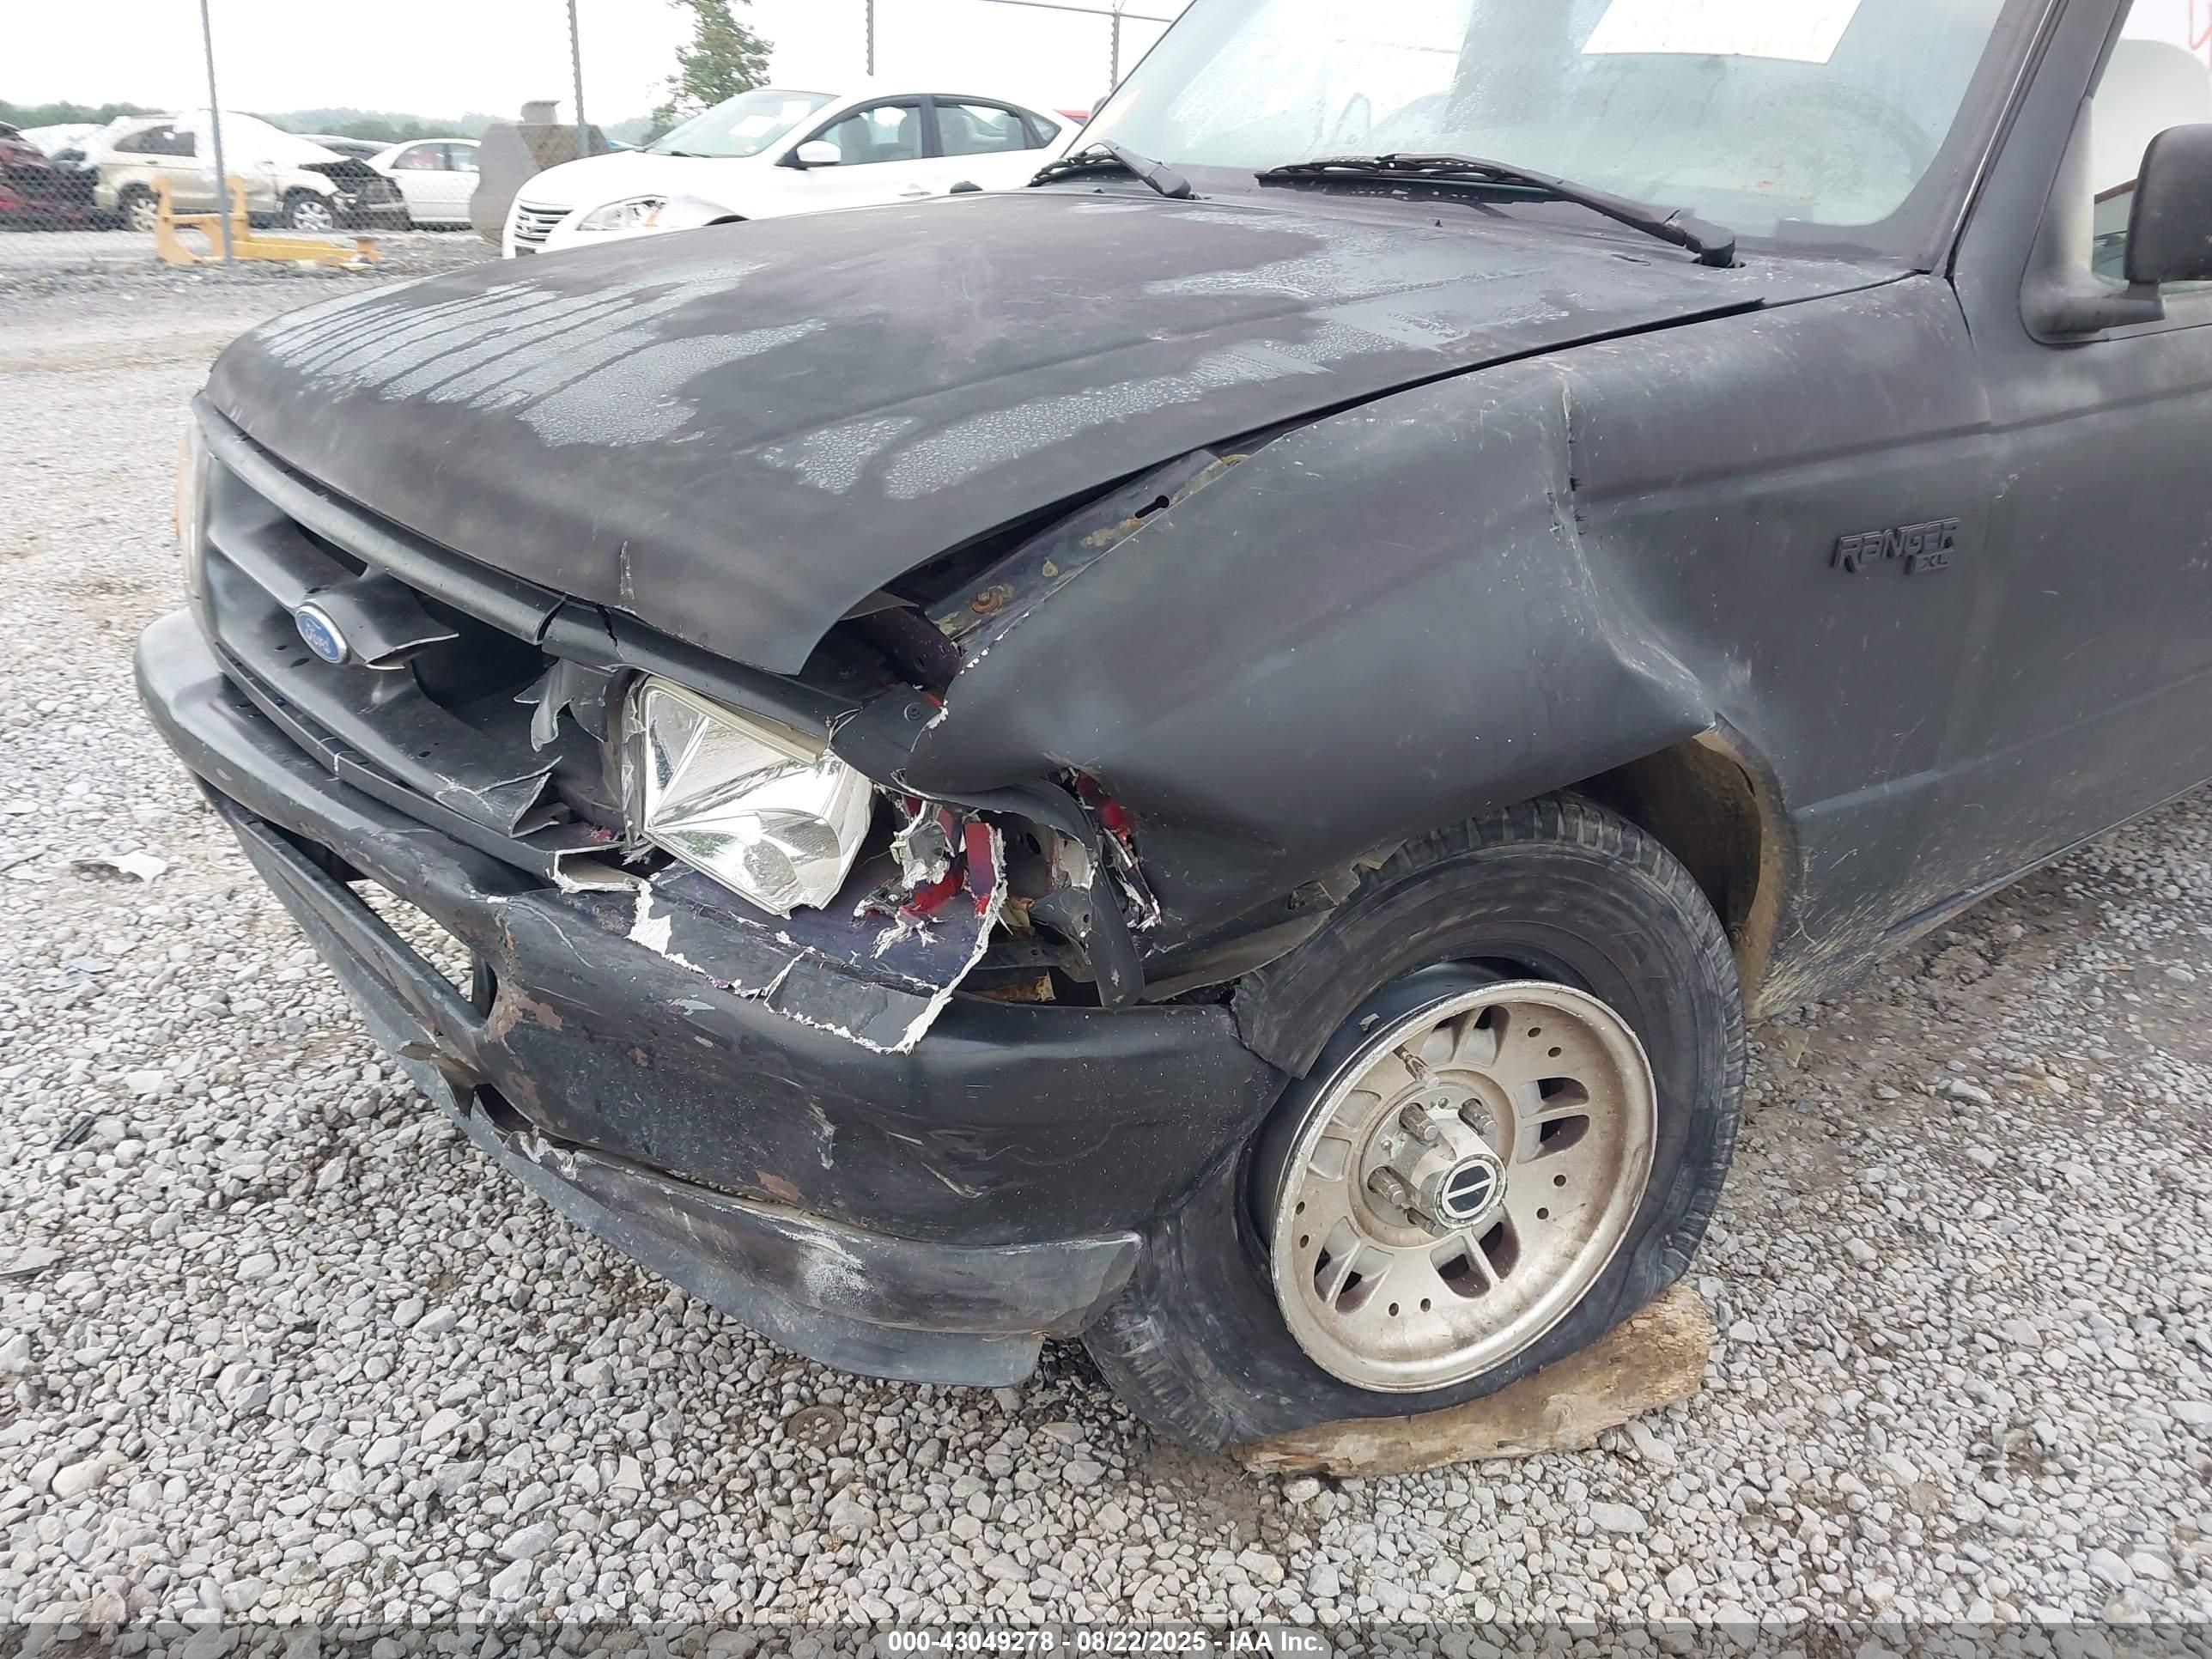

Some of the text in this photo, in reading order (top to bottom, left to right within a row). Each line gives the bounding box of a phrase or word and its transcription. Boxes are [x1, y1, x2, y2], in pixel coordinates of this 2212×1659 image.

[1831, 517, 1959, 572] RANGER
[1915, 550, 1953, 571] XL
[305, 617, 331, 653] Ford
